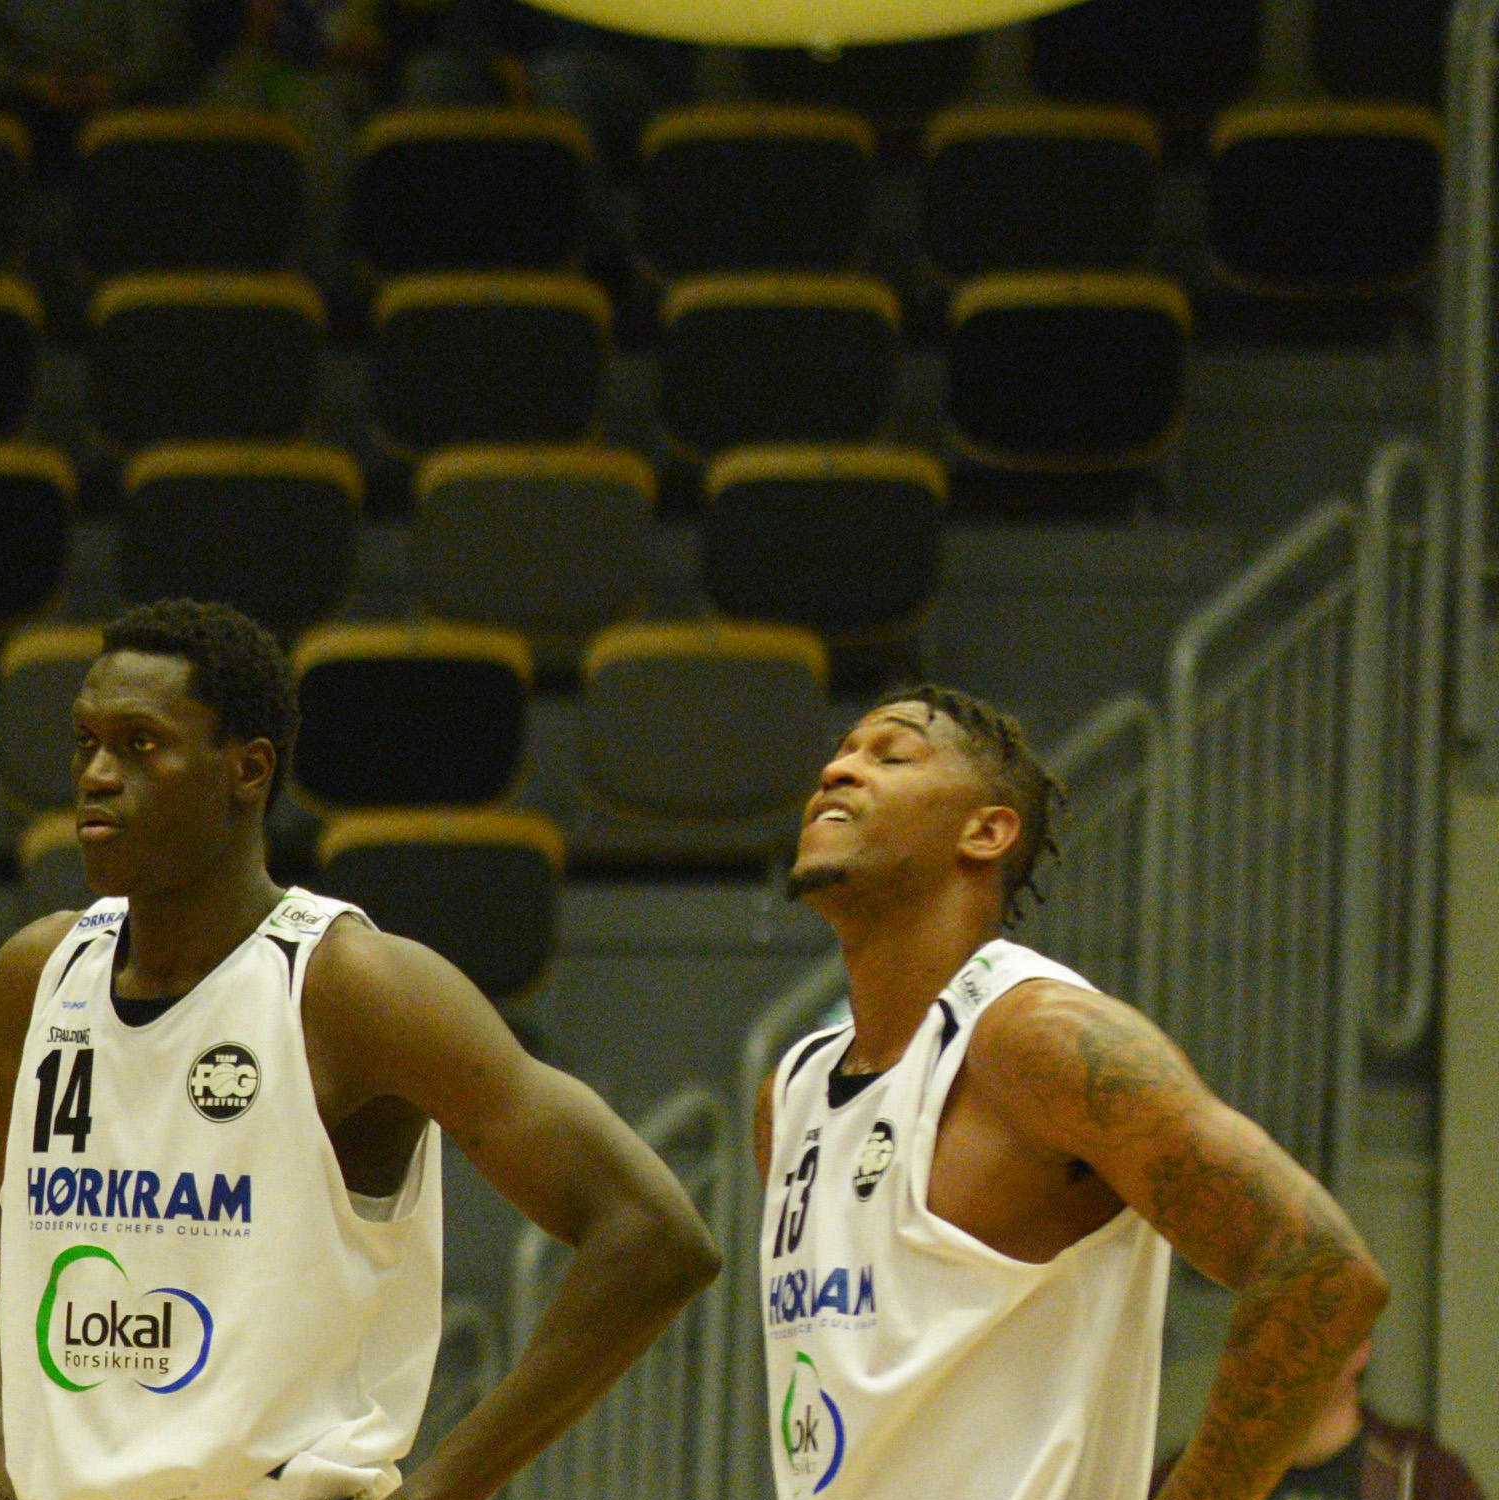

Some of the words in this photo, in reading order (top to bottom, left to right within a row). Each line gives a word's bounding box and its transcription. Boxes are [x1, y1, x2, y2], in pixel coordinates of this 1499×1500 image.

[33, 1048, 95, 1154] 14
[27, 1166, 252, 1223] HØRKRAM
[64, 1299, 173, 1349] Lokal
[64, 1350, 171, 1375] Forsikring
